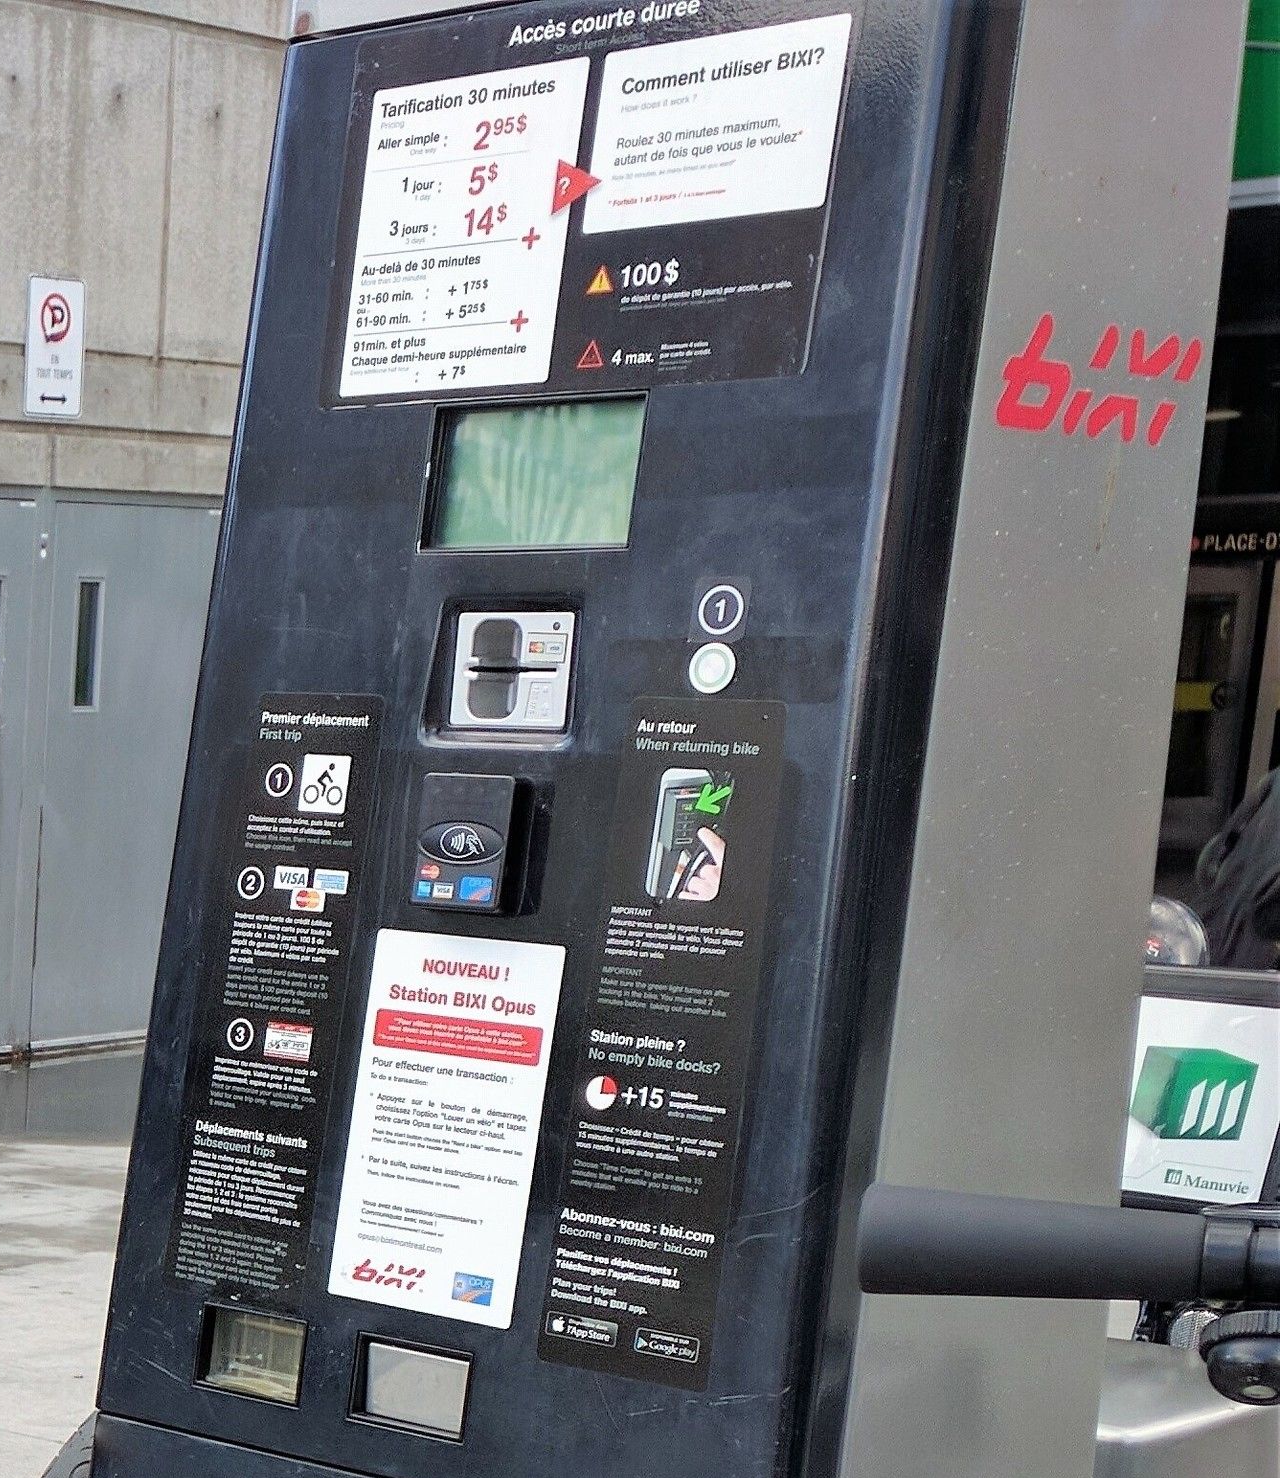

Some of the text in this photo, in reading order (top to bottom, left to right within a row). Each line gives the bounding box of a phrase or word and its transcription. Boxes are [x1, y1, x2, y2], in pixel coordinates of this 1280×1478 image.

[508, 19, 566, 47] Accès
[571, 8, 635, 34] courte
[622, 47, 825, 95] Comment utiliser BIXI?
[381, 79, 555, 118] Tarification 30 minutes
[378, 132, 440, 150] Aller simple
[617, 117, 780, 150] Roulez 30 minutes maximum,
[614, 152, 648, 167] autant
[651, 149, 665, 162] de
[668, 146, 689, 161] fois
[692, 144, 713, 159] que
[716, 138, 742, 153] vous
[747, 137, 757, 149] le
[412, 179, 434, 193] jour
[468, 162, 498, 195] 5$
[390, 202, 508, 237] 3 jours 14$
[362, 255, 481, 276] Au-delà de 30 minutes
[359, 293, 388, 305] 31-60
[392, 291, 414, 302] min.
[356, 315, 386, 328] 61-90
[389, 313, 411, 325] min.
[391, 337, 425, 349] et plus
[352, 344, 526, 368] Chaque demi-heure supplémentaire
[611, 349, 655, 365] 4 max.
[994, 312, 1203, 446] bixi
[715, 599, 727, 622] 1
[261, 711, 369, 728] Premier déplacement
[638, 719, 697, 734] Au retour
[260, 729, 302, 742] First trip
[636, 738, 760, 756] When returning bike
[246, 875, 256, 891] 2
[279, 872, 305, 885] VISA
[611, 906, 652, 916] IMPORTANT
[423, 958, 500, 981] NOUVEAU
[390, 984, 536, 1016] Station BIXI Opus
[235, 1026, 245, 1042] 3
[590, 1029, 674, 1051] Station pleine
[372, 1057, 508, 1083] Pour effectuer une transaction
[589, 1048, 721, 1075] No empty bike docks?
[377, 1093, 405, 1104] Appuyez
[441, 1102, 465, 1112] bouton
[487, 1109, 528, 1122] démarrage,
[622, 1086, 665, 1109] +15
[376, 1105, 410, 1115] choisissez
[413, 1109, 438, 1119] l'option
[507, 1124, 527, 1133] tapez
[393, 1118, 410, 1126] carte
[412, 1120, 430, 1129] Opus
[454, 1126, 477, 1135] lecteur
[196, 1120, 307, 1149] Déplacements suivants
[194, 1135, 276, 1158] Subsequent trips
[369, 1156, 380, 1164] Par
[390, 1160, 408, 1169] suite,
[410, 1163, 430, 1172] suivez
[445, 1169, 485, 1181] instructions
[1184, 1174, 1249, 1196] Manuvie
[392, 1203, 402, 1211] des
[561, 1207, 715, 1244] Abonnez-vous bixi.com
[559, 1224, 602, 1241] Become
[663, 1241, 707, 1258] bixi.com
[555, 1259, 607, 1276] Téléchargez
[607, 1268, 660, 1286] l'application
[556, 1247, 672, 1276] Planifiez vos déplacements
[352, 1259, 426, 1290] bixi
[552, 1277, 617, 1297] Plan your trips!
[551, 1289, 593, 1303] Download
[594, 1296, 608, 1306] the
[628, 1303, 648, 1315] app.
[648, 1340, 679, 1354] Google
